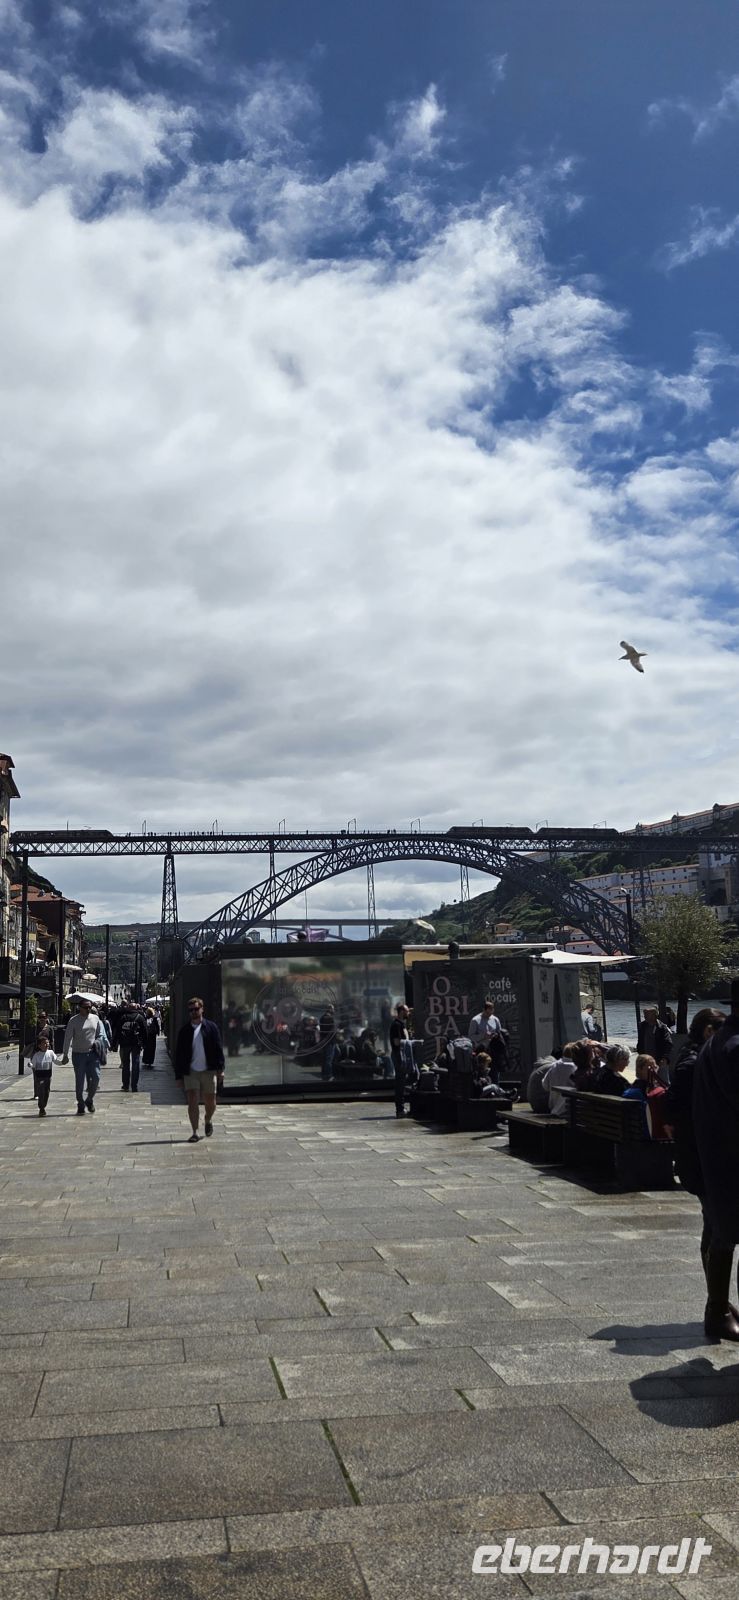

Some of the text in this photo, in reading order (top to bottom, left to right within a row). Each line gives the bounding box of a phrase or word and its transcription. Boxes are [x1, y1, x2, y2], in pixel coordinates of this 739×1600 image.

[489, 976, 512, 991] café
[428, 995, 470, 1016] BRI
[424, 1016, 461, 1036] GA
